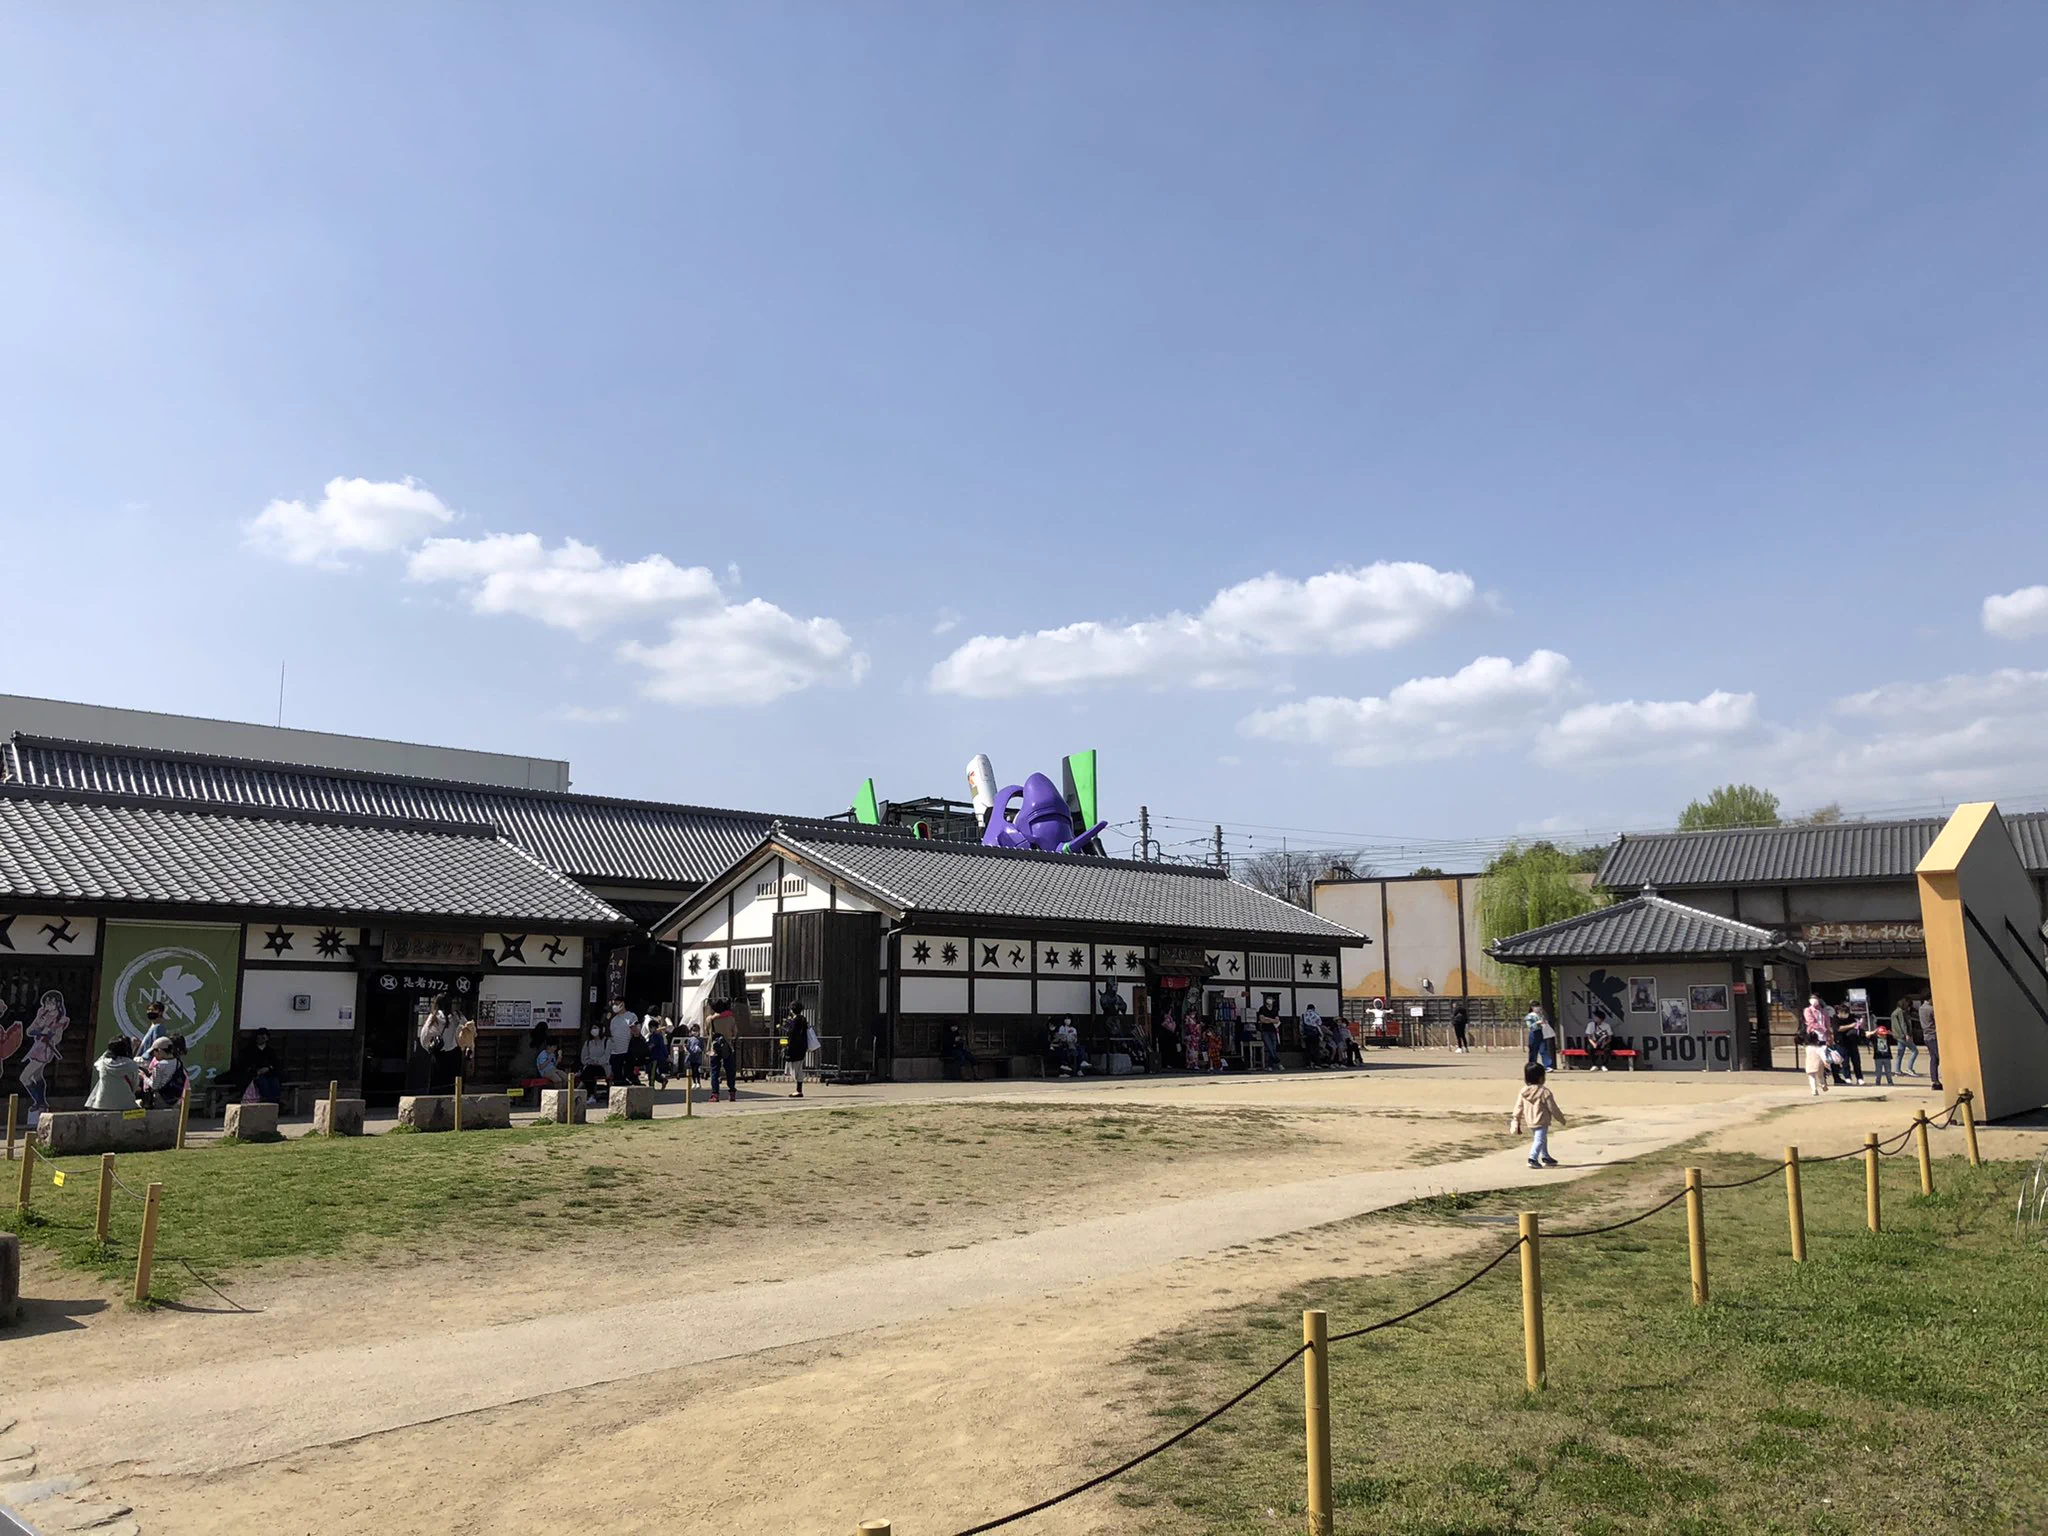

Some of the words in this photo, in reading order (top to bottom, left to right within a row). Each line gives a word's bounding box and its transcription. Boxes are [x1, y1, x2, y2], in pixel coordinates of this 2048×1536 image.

[403, 976, 449, 991] 忍者カフェ
[1643, 1035, 1730, 1062] PHOTO
